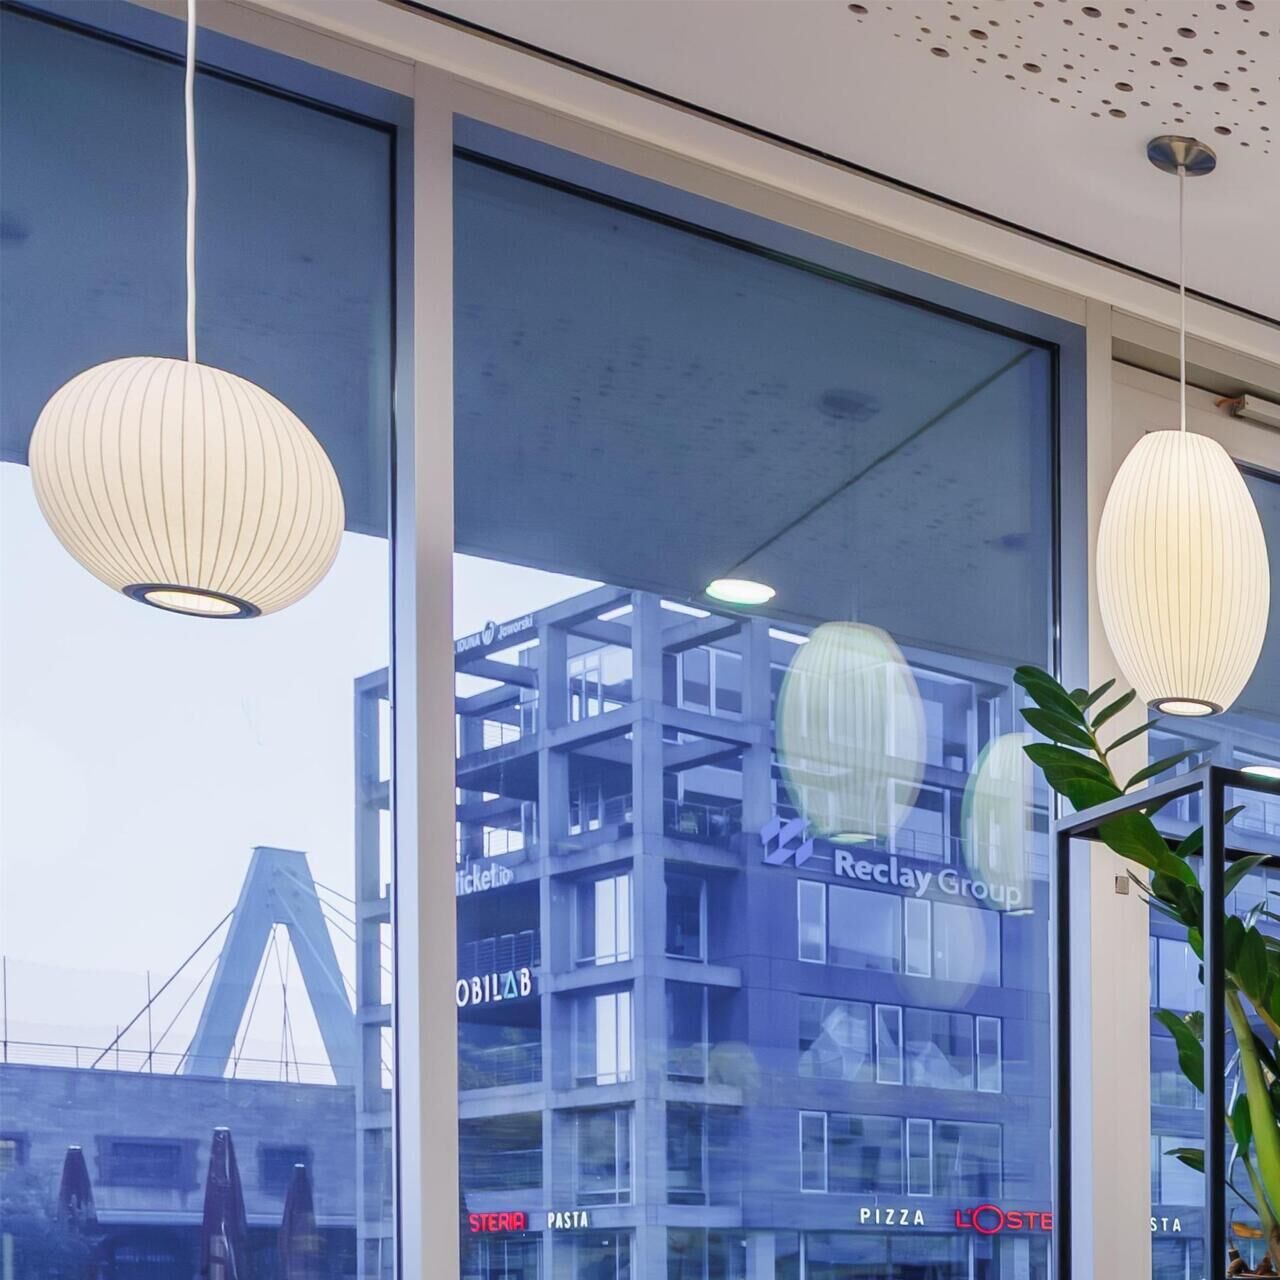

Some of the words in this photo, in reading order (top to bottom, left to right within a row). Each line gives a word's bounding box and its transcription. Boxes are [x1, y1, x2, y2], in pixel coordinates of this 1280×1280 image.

[834, 849, 932, 897] Reclay
[937, 868, 1021, 911] Group
[547, 1211, 588, 1229] PASTA
[860, 1207, 925, 1226] PIZZA
